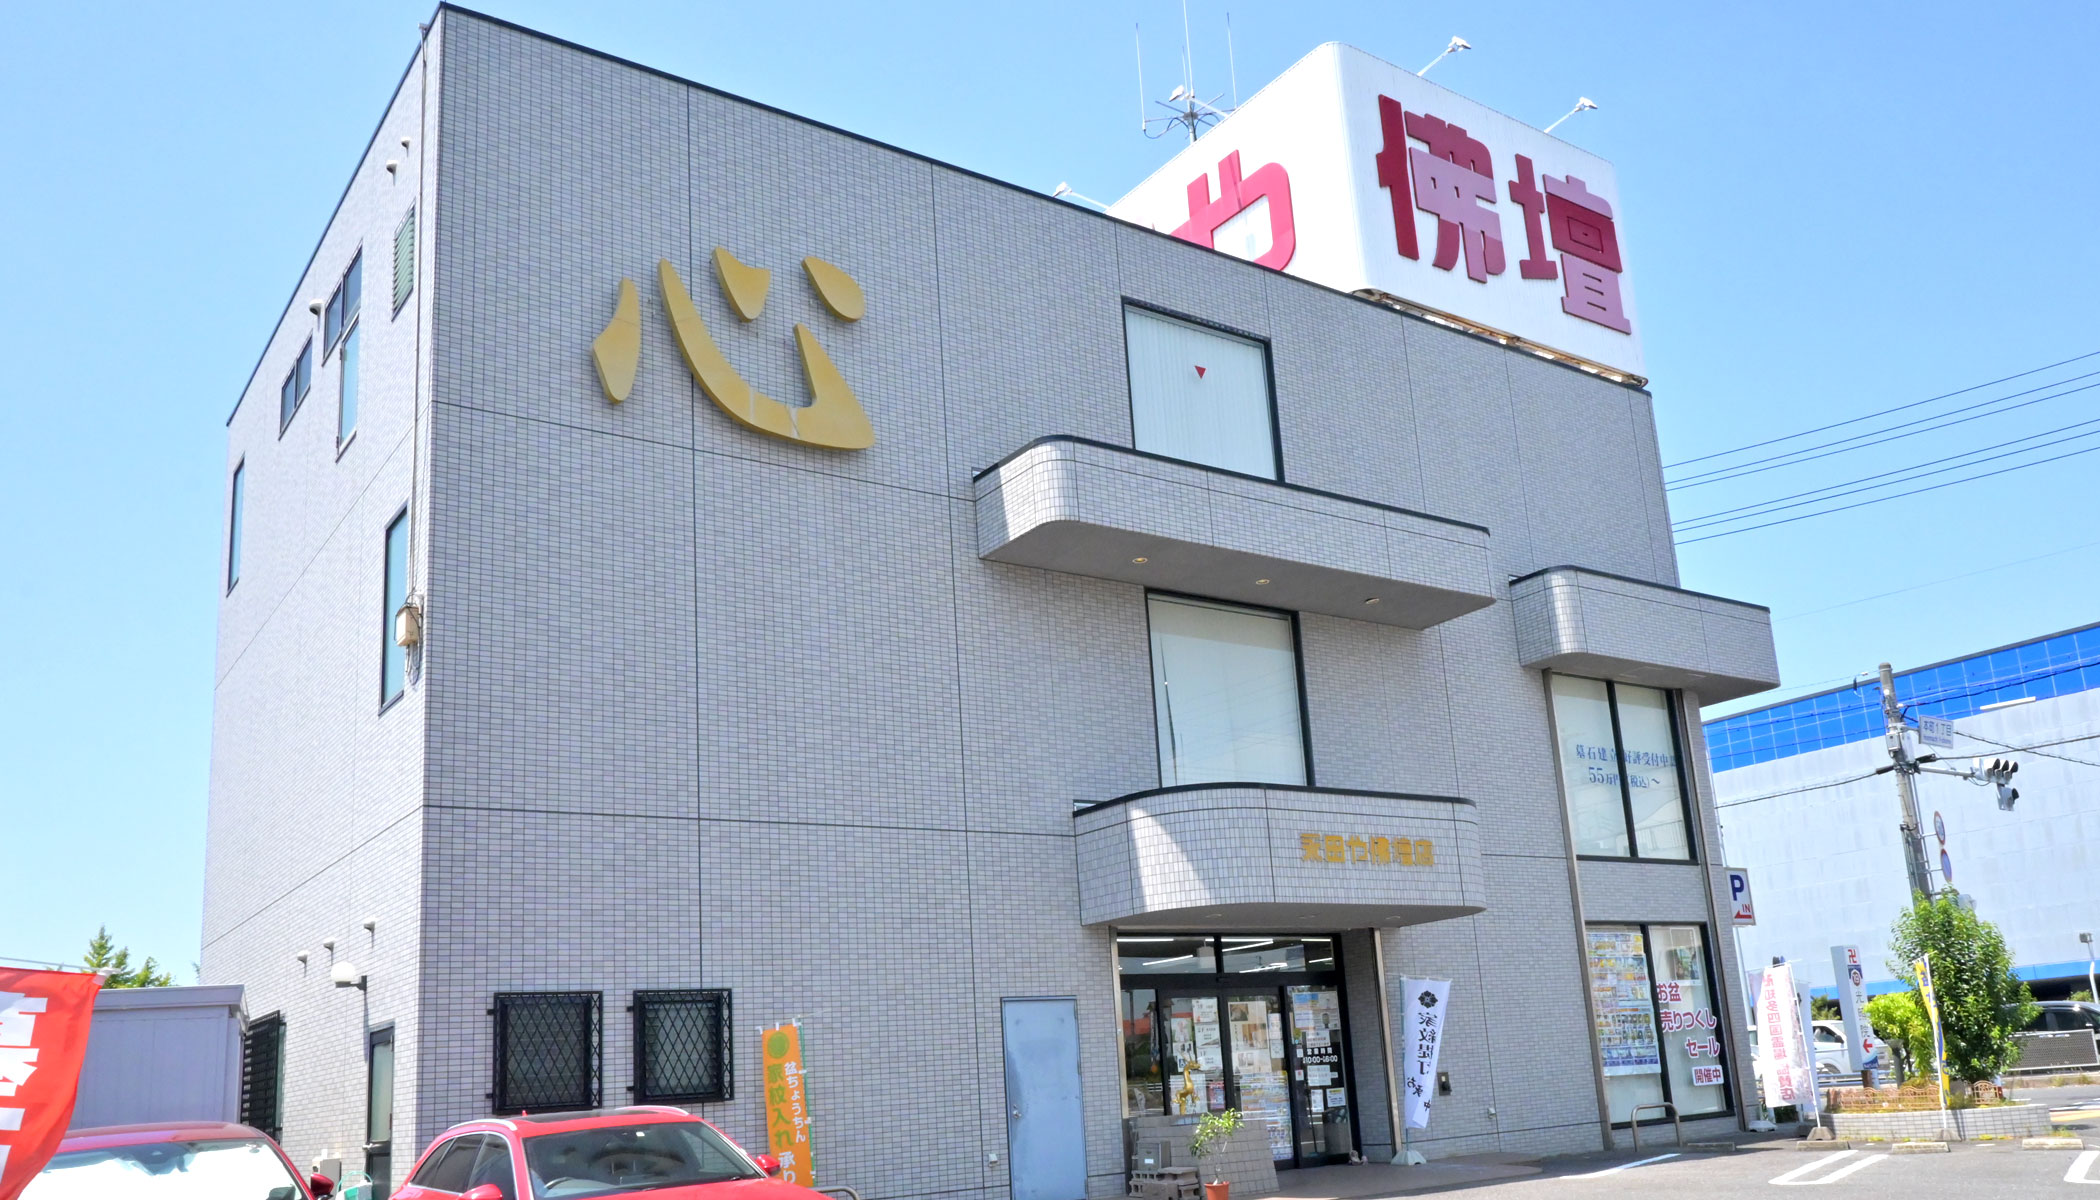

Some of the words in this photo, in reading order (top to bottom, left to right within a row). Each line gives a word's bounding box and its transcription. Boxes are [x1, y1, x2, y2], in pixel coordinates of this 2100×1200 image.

[1170, 149, 1296, 271] や
[591, 245, 876, 450] 心
[1729, 874, 1744, 901] P
[1742, 904, 1751, 913] IN
[1656, 981, 1681, 1002] お盆
[1660, 1009, 1717, 1032] 売りつくし
[1686, 1037, 1720, 1058] セール
[1694, 1067, 1721, 1084] 開催中
[784, 1061, 806, 1143] 盆ちょうちん
